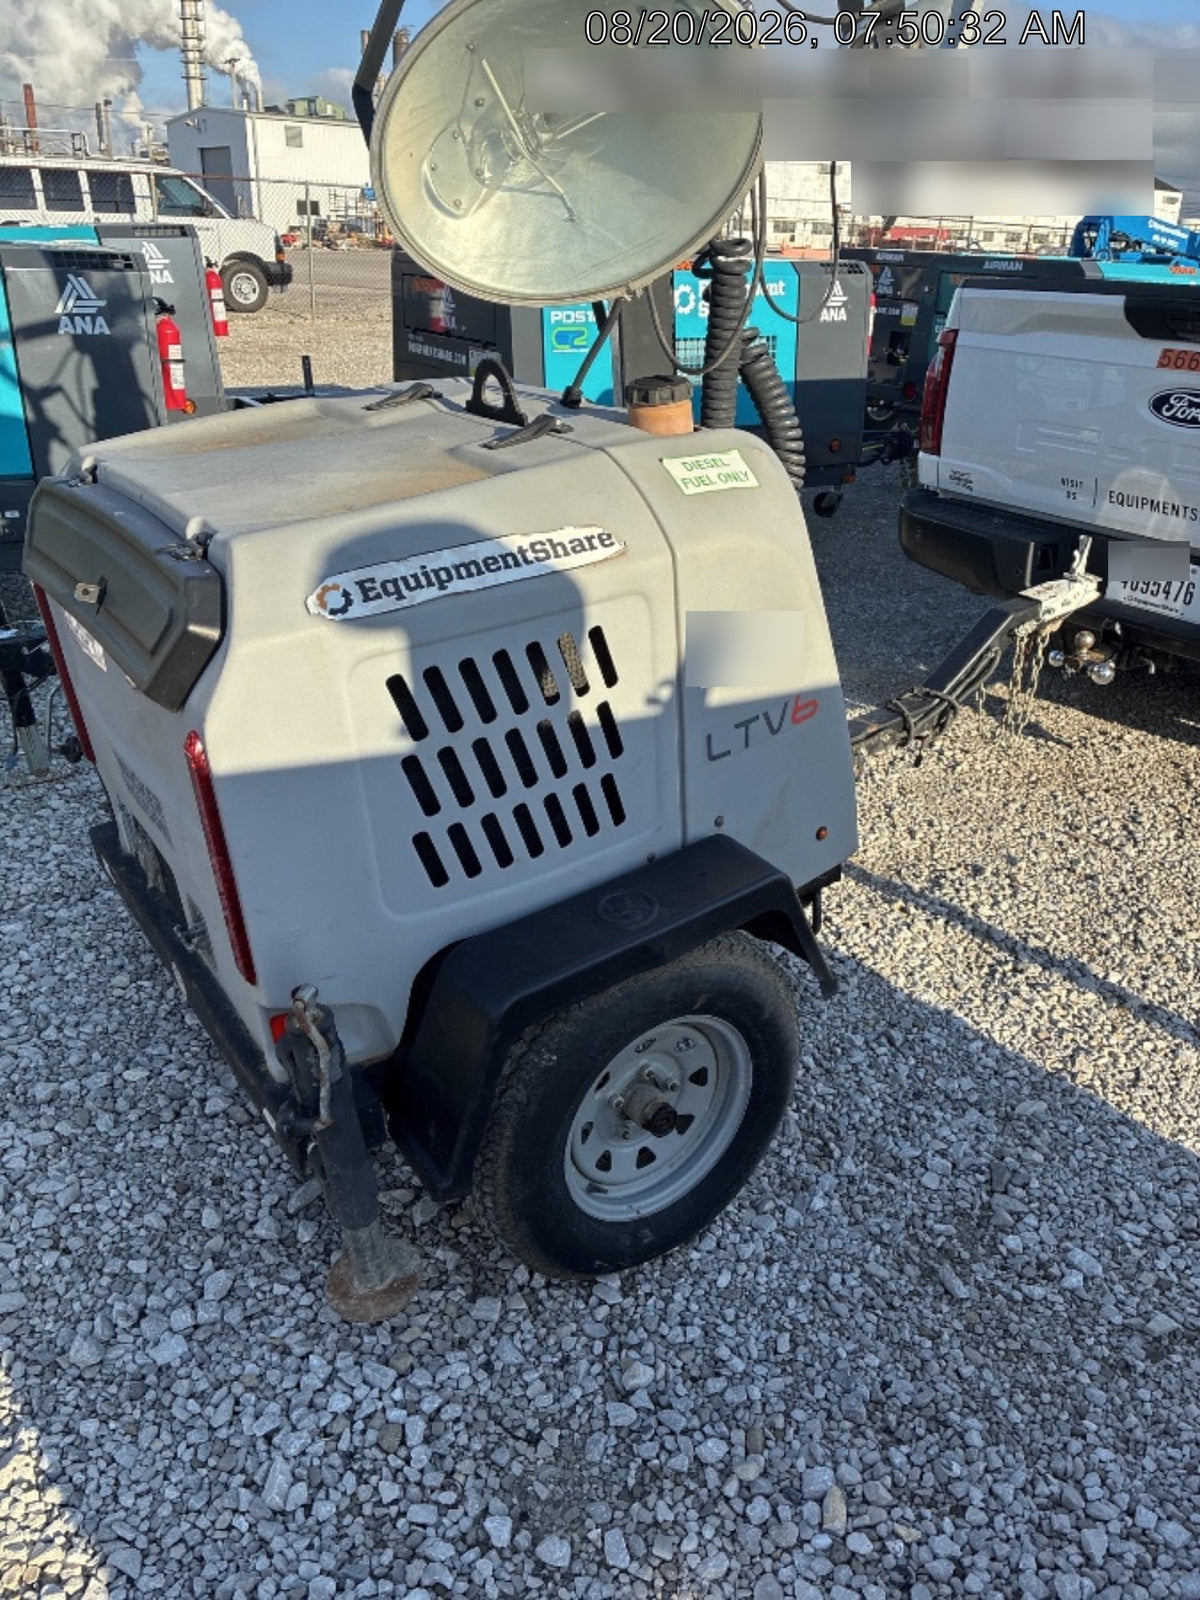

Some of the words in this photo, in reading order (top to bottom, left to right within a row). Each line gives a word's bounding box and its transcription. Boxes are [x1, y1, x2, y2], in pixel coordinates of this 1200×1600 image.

[150, 270, 174, 284] NA
[820, 307, 847, 322] ANA
[58, 316, 111, 335] ANA
[1159, 348, 1200, 371] 566
[1162, 394, 1200, 422] For
[681, 458, 731, 472] DIESEL
[680, 474, 717, 489] FUEL
[717, 470, 750, 484] ONLY
[354, 530, 616, 604] EquipmentShare
[705, 693, 819, 762] LTV6
